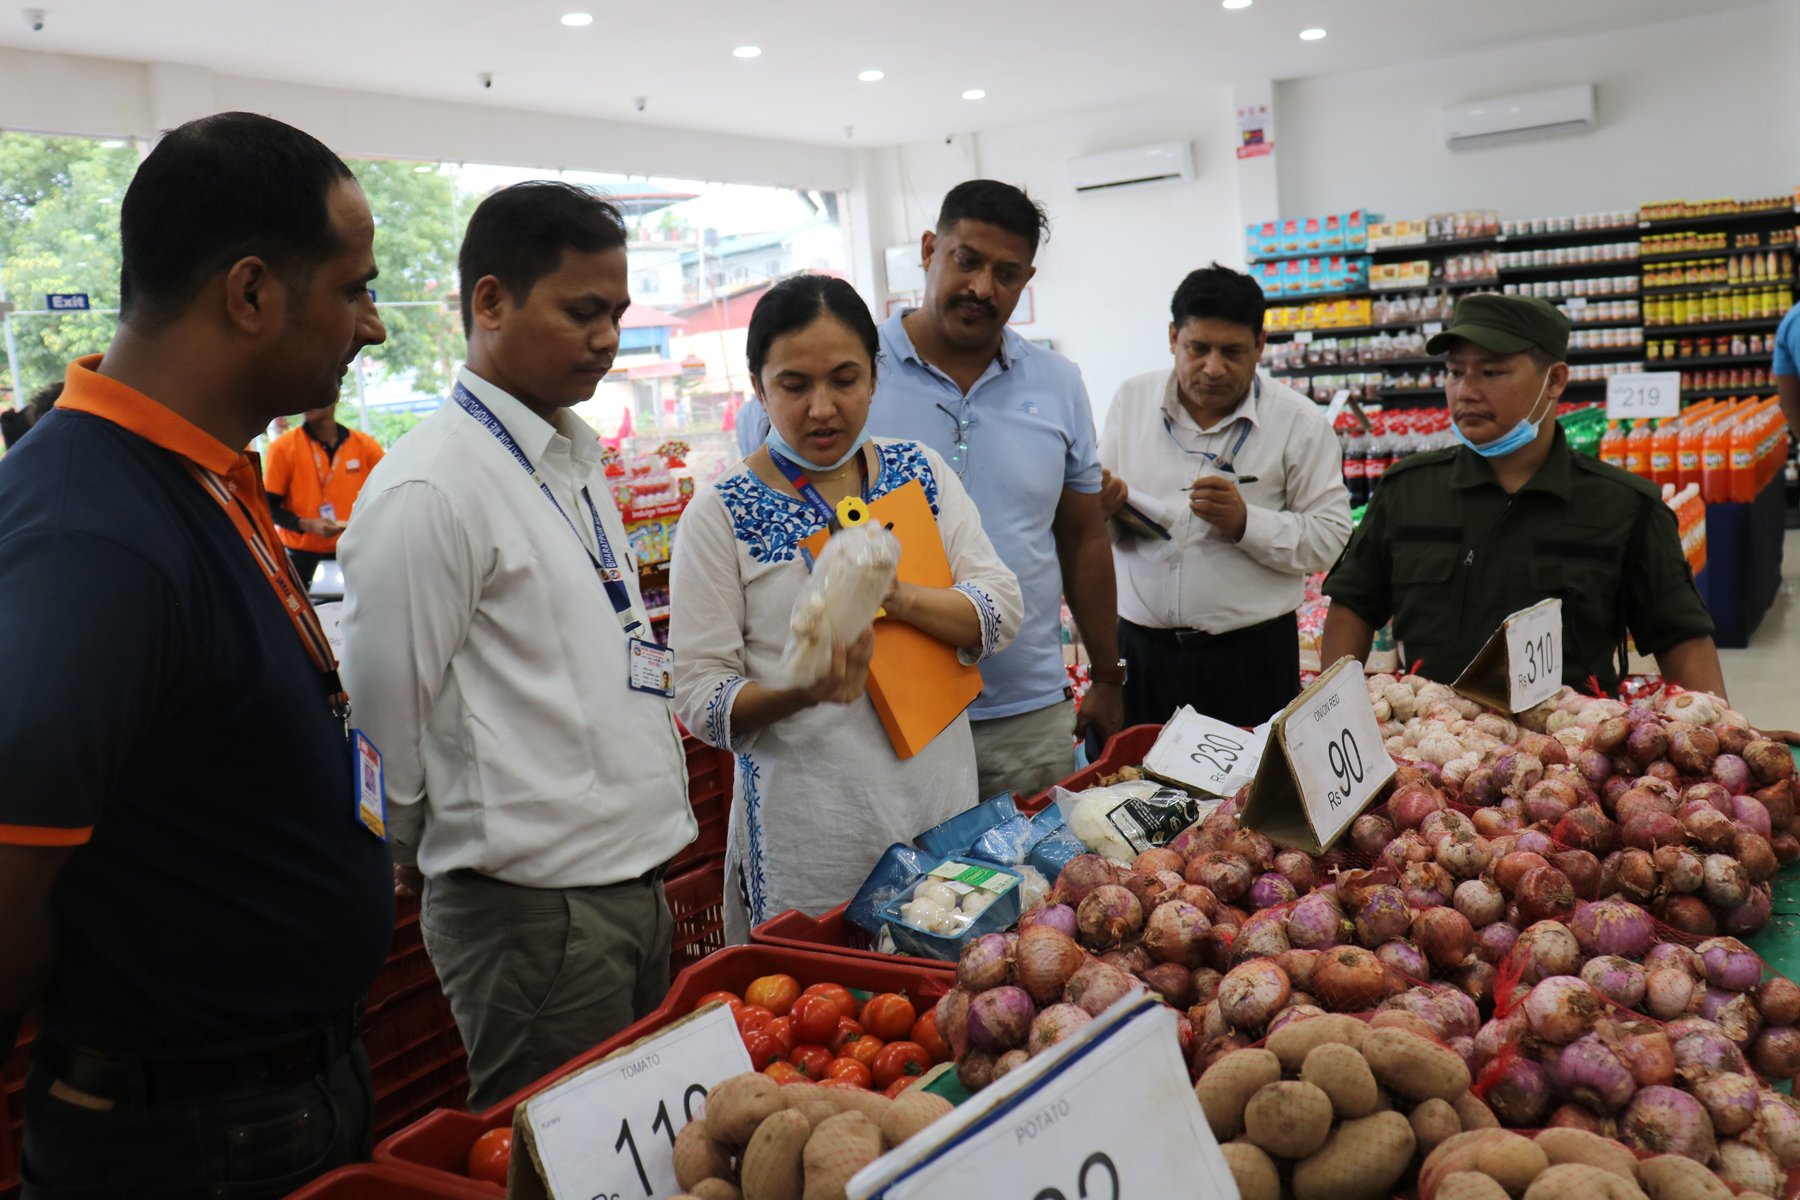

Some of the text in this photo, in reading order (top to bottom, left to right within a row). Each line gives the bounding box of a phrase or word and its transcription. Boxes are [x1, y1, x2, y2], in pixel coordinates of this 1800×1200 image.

[52, 295, 85, 308] Exit
[1622, 387, 1660, 407] 219
[1518, 674, 1527, 688] Rs
[1525, 632, 1553, 684] 310
[1314, 694, 1340, 721] ONION RED
[1190, 733, 1244, 774] 230
[1328, 728, 1364, 812] Rs 90
[620, 1053, 660, 1081] TOMATO
[1015, 1099, 1071, 1146] POTATO
